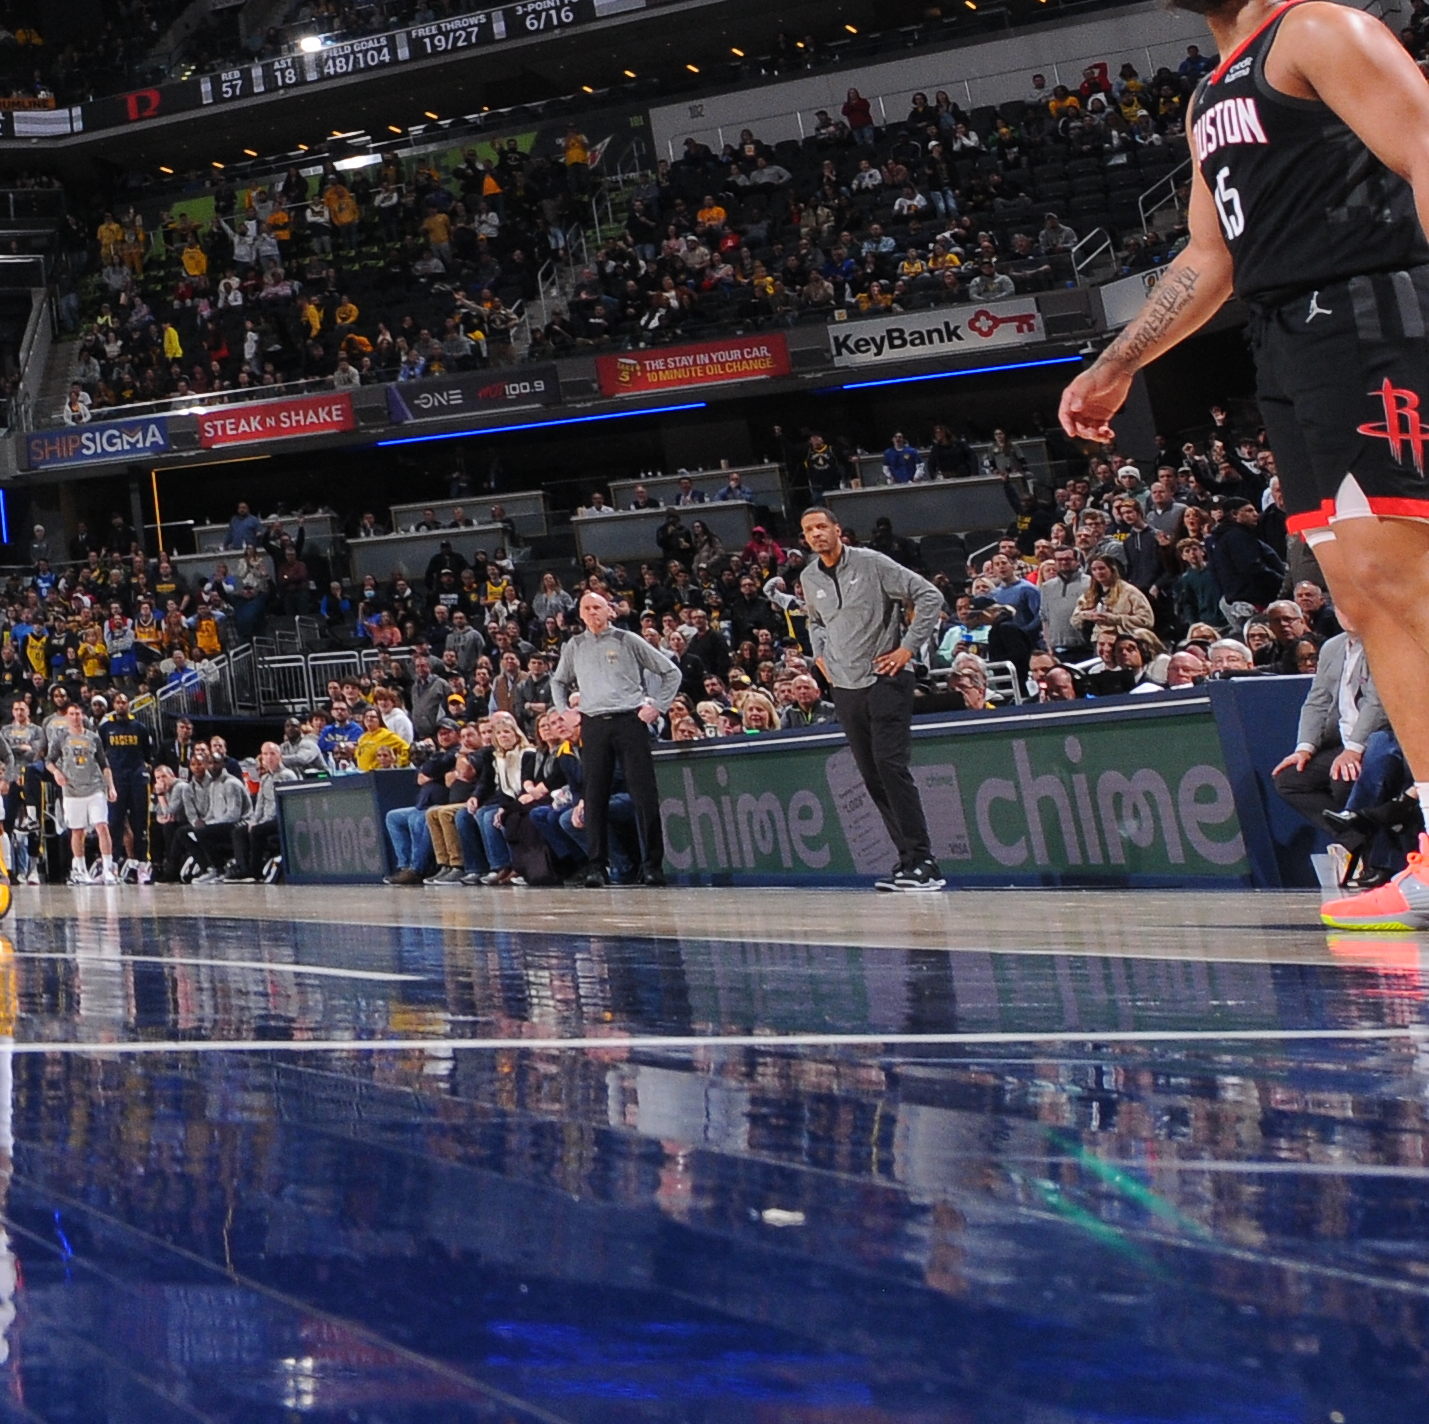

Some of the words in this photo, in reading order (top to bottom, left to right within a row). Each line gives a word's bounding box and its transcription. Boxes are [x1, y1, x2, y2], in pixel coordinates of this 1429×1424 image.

[411, 23, 438, 39] FREE
[440, 14, 487, 31] THROWS
[525, 6, 574, 31] 6/16
[353, 37, 387, 51] GOALS
[423, 27, 479, 53] 19/27
[273, 58, 292, 70] AST
[323, 47, 391, 76] 48/104
[221, 80, 242, 98] 57
[274, 68, 296, 86] 18
[1193, 98, 1269, 168] USTON
[834, 320, 964, 359] KeyBank
[644, 358, 666, 372] THE
[667, 356, 693, 369] STAY
[696, 353, 709, 365] IN
[710, 349, 741, 364] YOUR
[647, 372, 658, 382] 10
[659, 368, 703, 381] MINUTE
[706, 364, 724, 376] OIL
[505, 380, 545, 396] 100.9
[204, 416, 261, 438] STEAK
[266, 416, 276, 427] N
[280, 404, 344, 428] SHAKE
[31, 424, 164, 463] SHIPSIGMA
[974, 736, 1247, 867] chime
[660, 764, 831, 870] chime
[292, 798, 382, 873] chime
